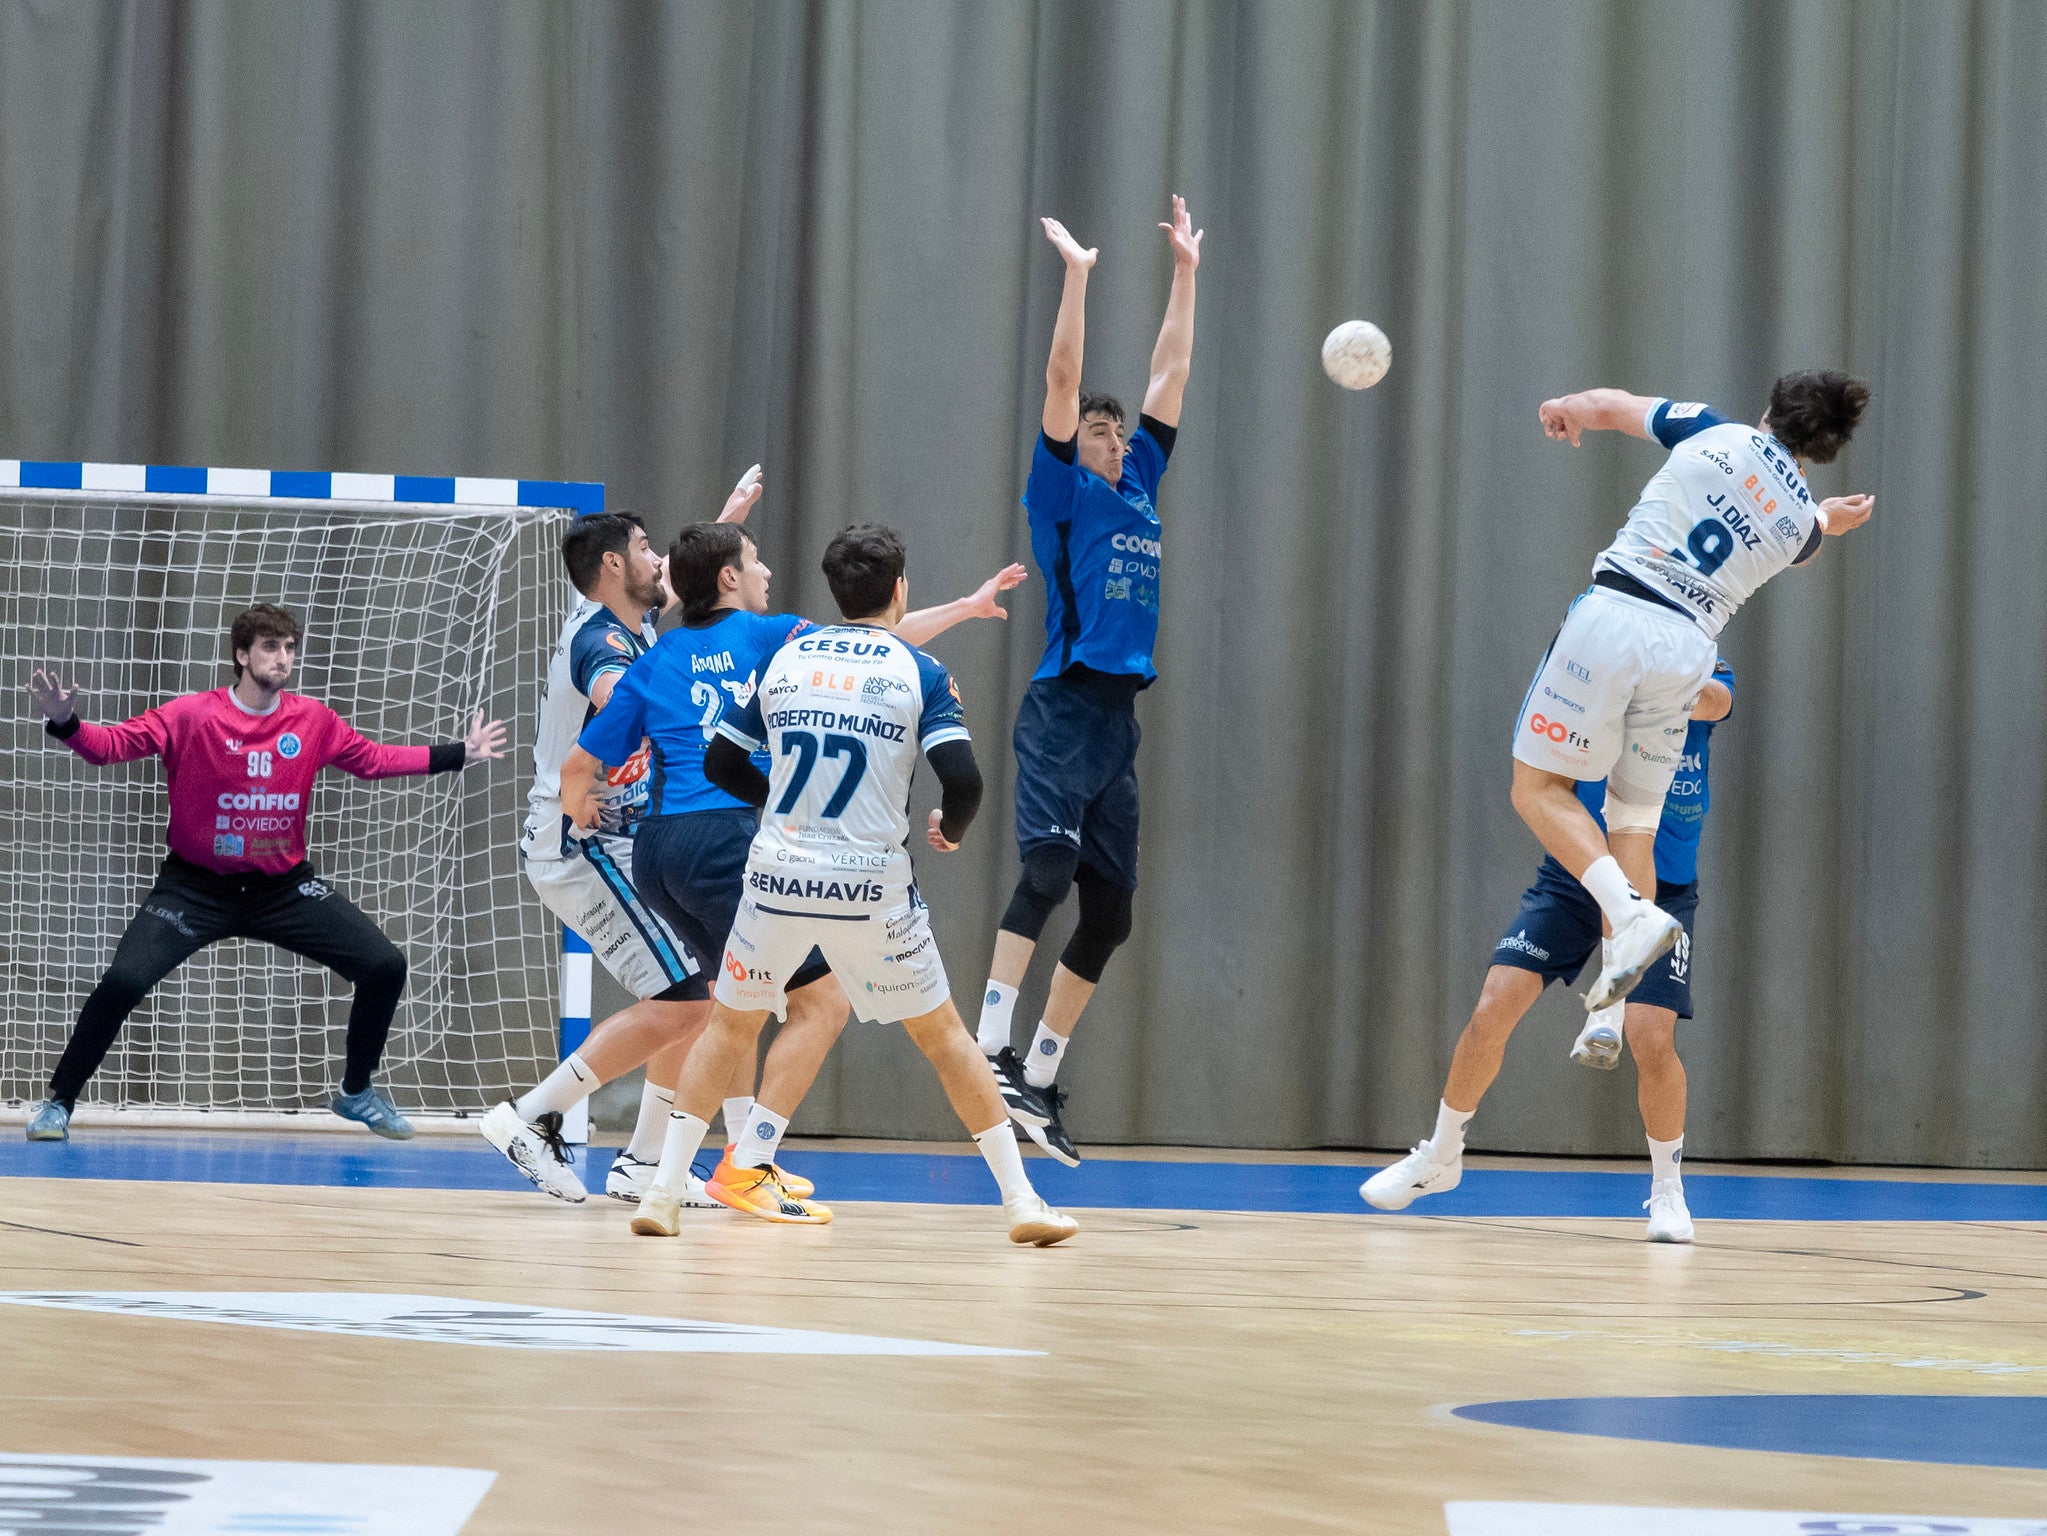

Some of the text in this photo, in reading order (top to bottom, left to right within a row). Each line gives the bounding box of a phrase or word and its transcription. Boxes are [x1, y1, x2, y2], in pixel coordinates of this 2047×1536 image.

[1700, 449, 1733, 475] SAYCO
[1706, 493, 1725, 512] J.
[1721, 505, 1762, 551] DÍAZ
[1671, 518, 1734, 577] 9
[799, 640, 891, 658] CESUR
[768, 685, 798, 696] SAYCO
[864, 676, 910, 693] ANTONIO
[767, 710, 907, 743] ROBERTO MUÑOZ
[247, 750, 272, 778] 96
[774, 731, 867, 819] 77
[232, 817, 291, 831] OVIEDO
[831, 852, 887, 867] VÉRTICE
[750, 871, 884, 902] BENAHAVÍS
